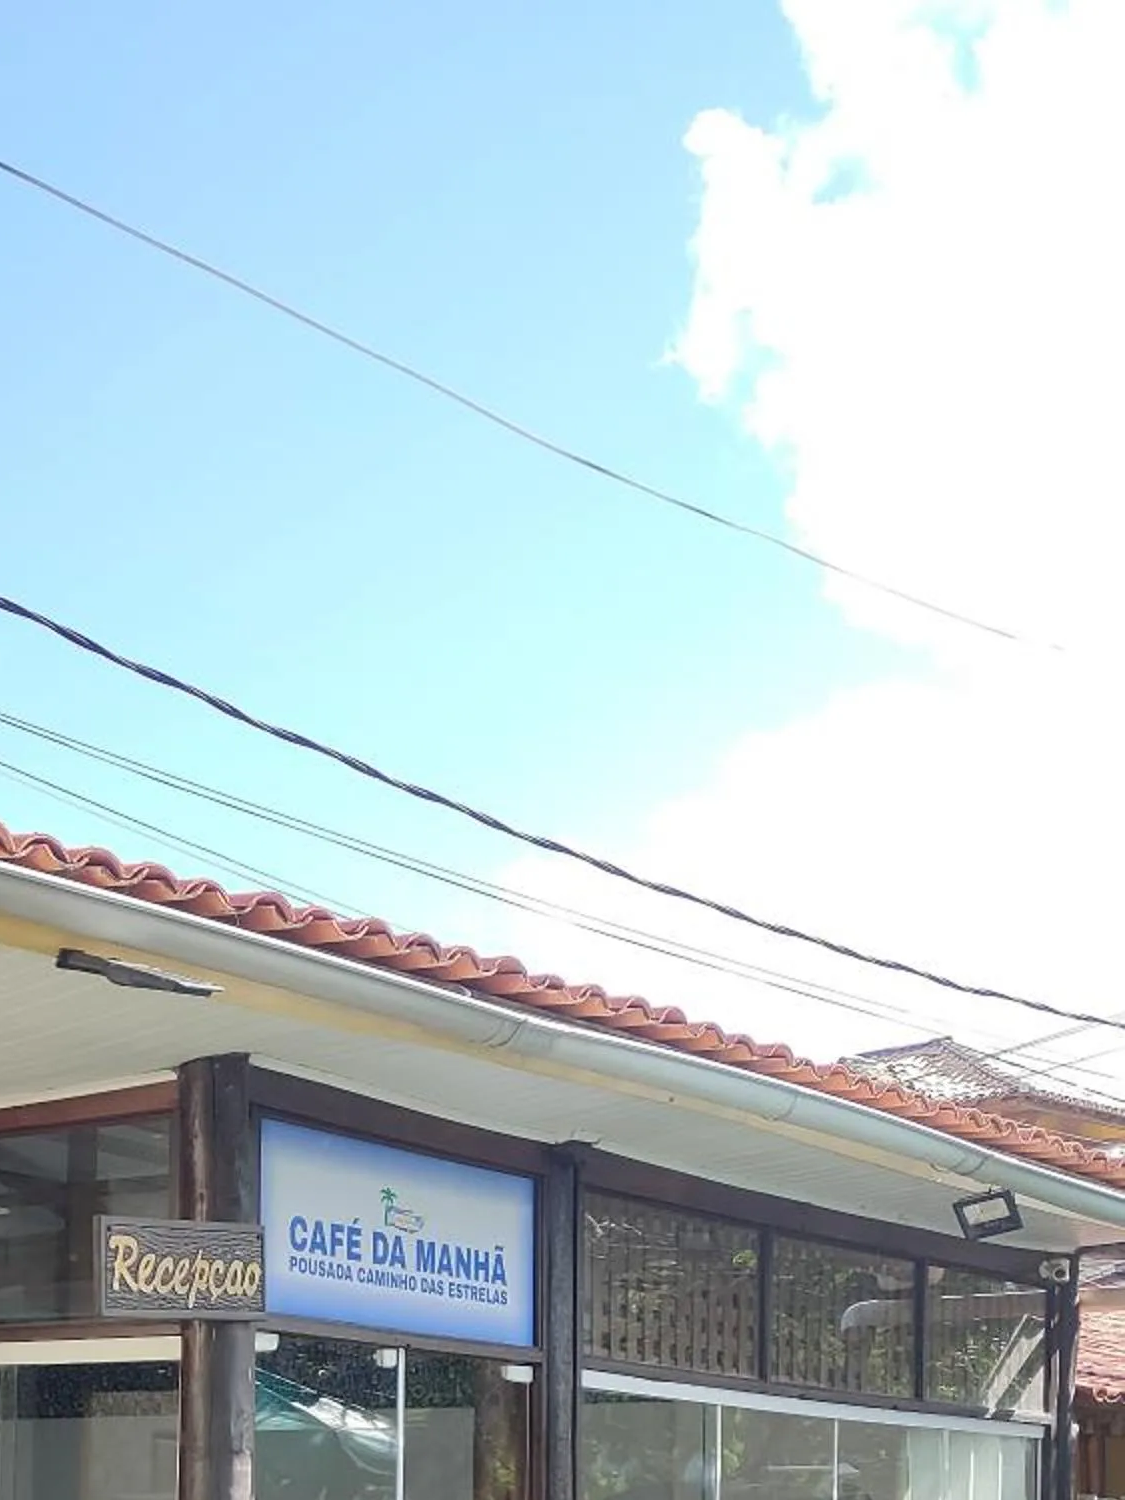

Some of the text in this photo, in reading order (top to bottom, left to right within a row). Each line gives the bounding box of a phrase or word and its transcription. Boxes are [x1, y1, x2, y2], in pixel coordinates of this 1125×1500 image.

[289, 1214, 363, 1262] CAFÉ
[372, 1230, 406, 1270] DA
[415, 1238, 508, 1286] MANHÃ
[289, 1255, 509, 1306] POUSADA CAMINHO DAS ESTRELAS
